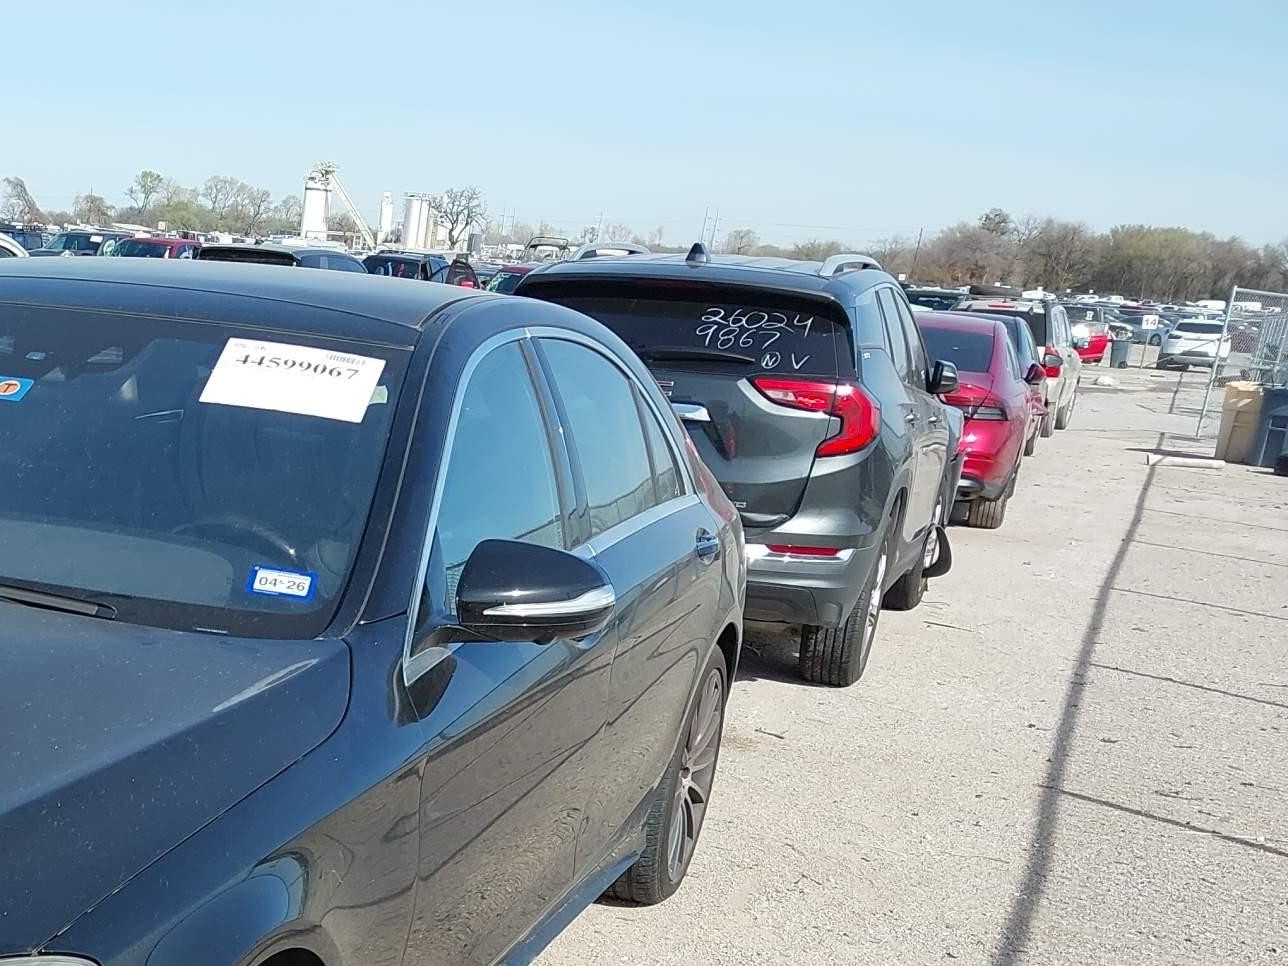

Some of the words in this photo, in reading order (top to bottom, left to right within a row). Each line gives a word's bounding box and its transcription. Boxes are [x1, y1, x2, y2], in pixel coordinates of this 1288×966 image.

[701, 307, 814, 338] 26024
[1144, 318, 1157, 326] 14
[696, 324, 780, 349] 9867
[235, 353, 360, 380] 44599067
[791, 353, 810, 370] V
